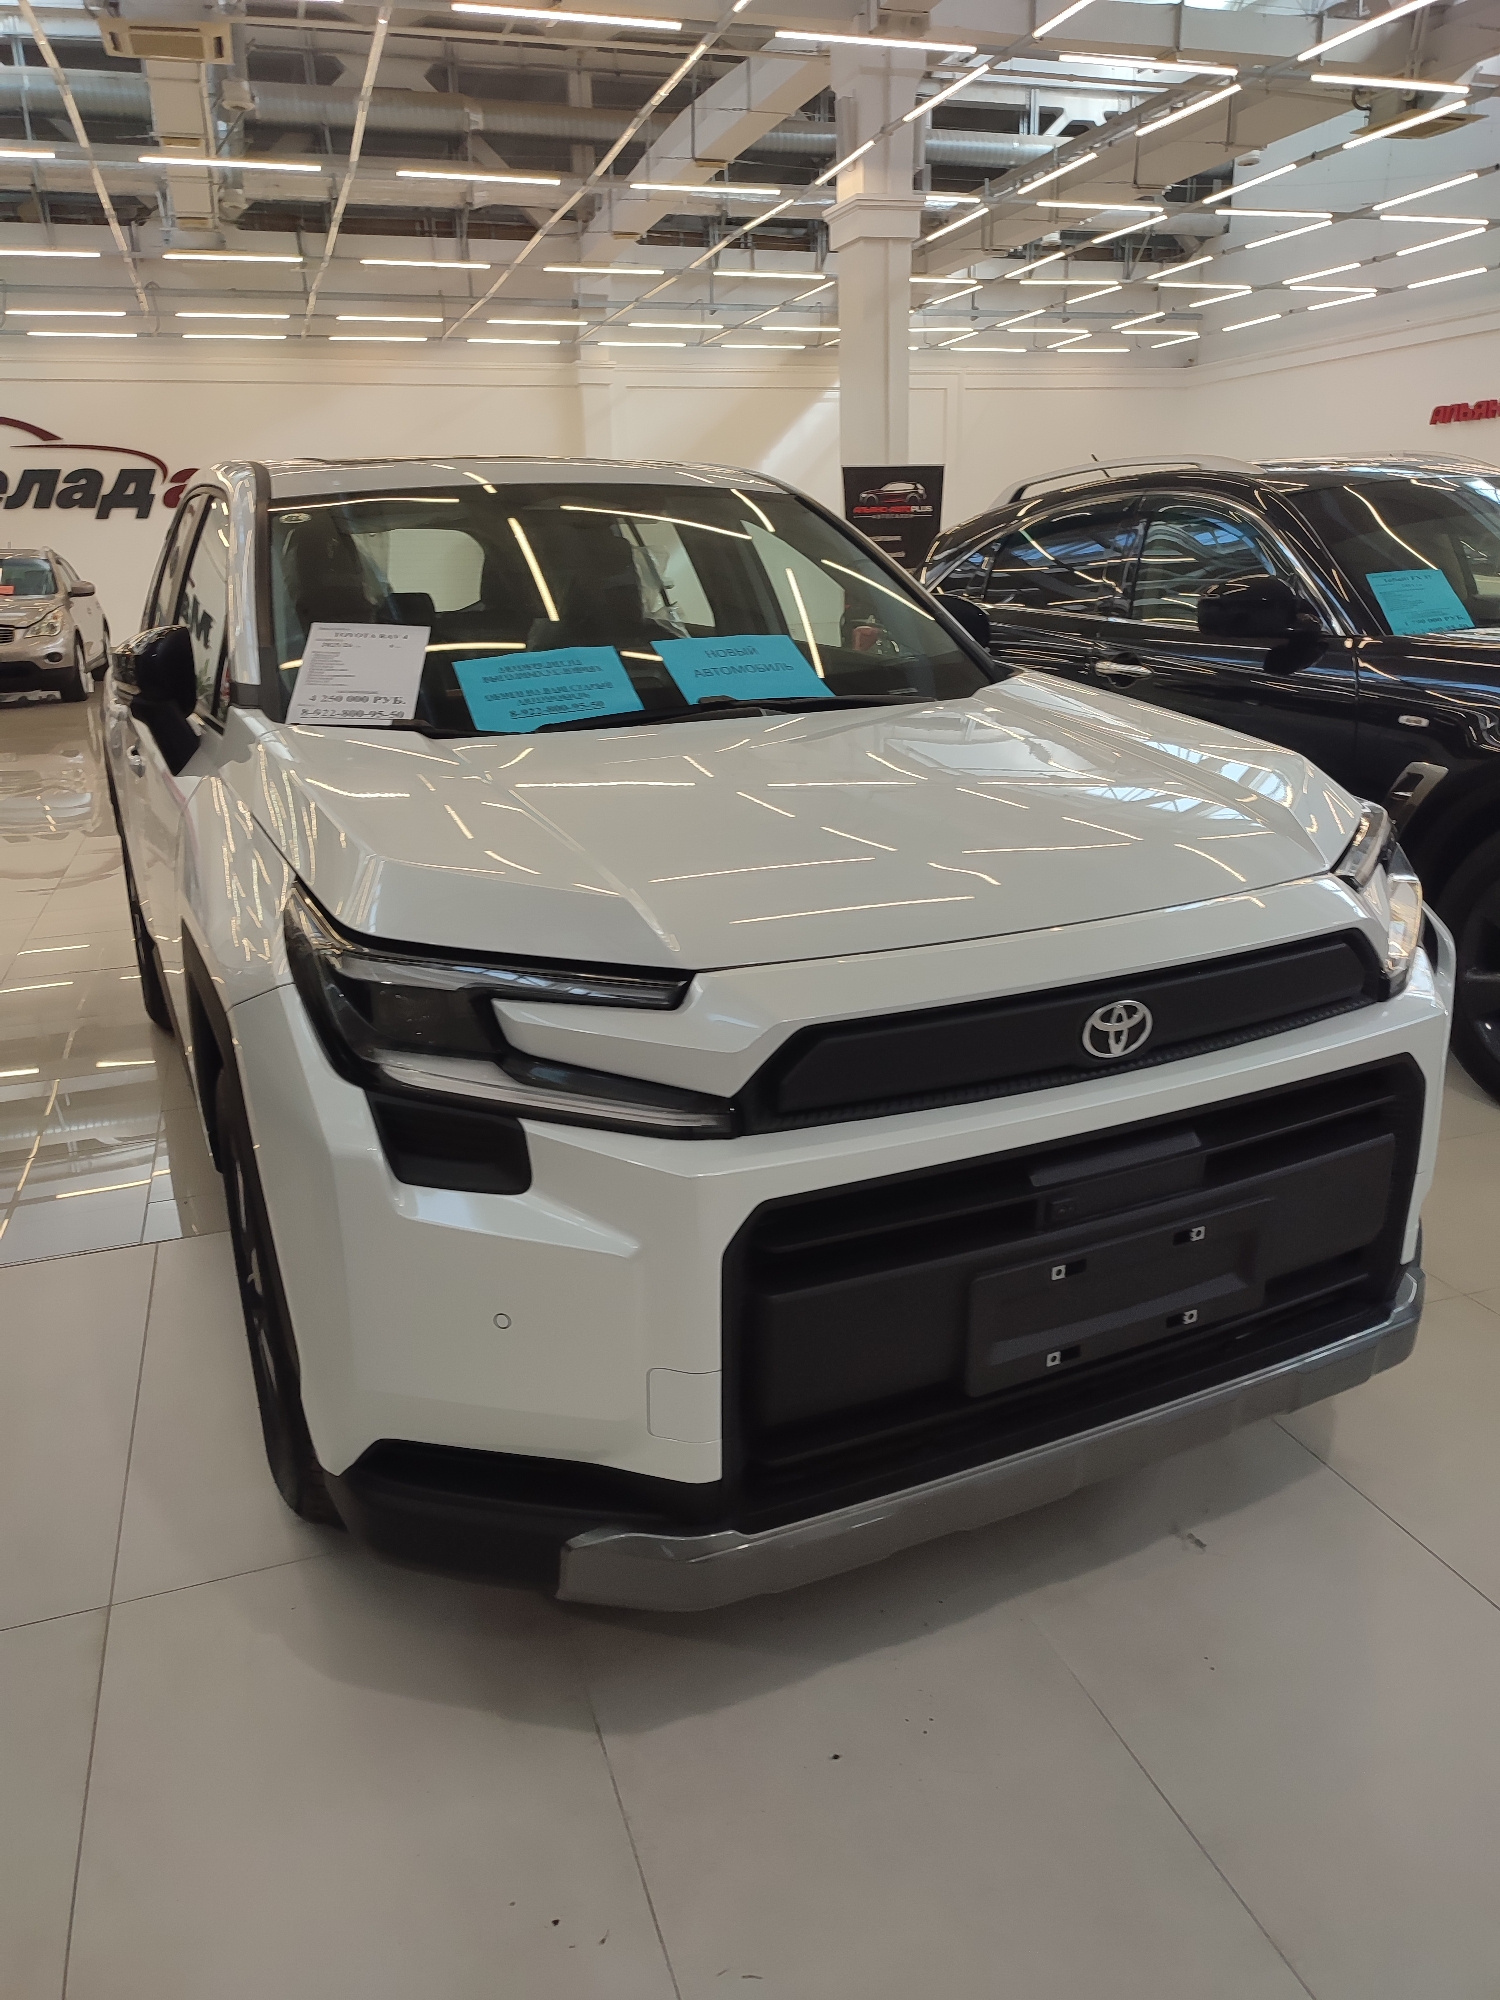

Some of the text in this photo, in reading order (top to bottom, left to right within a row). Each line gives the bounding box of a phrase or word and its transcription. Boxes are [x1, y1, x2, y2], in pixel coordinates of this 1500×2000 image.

[1429, 399, 1500, 425] АЛЬЯН
[0, 468, 200, 519] лада
[704, 645, 759, 658] НОВЫЙ
[693, 662, 794, 678] АВТОМОБИЛЬ
[320, 694, 344, 703] 250
[346, 695, 369, 703] 000
[373, 695, 406, 705] РУБ.
